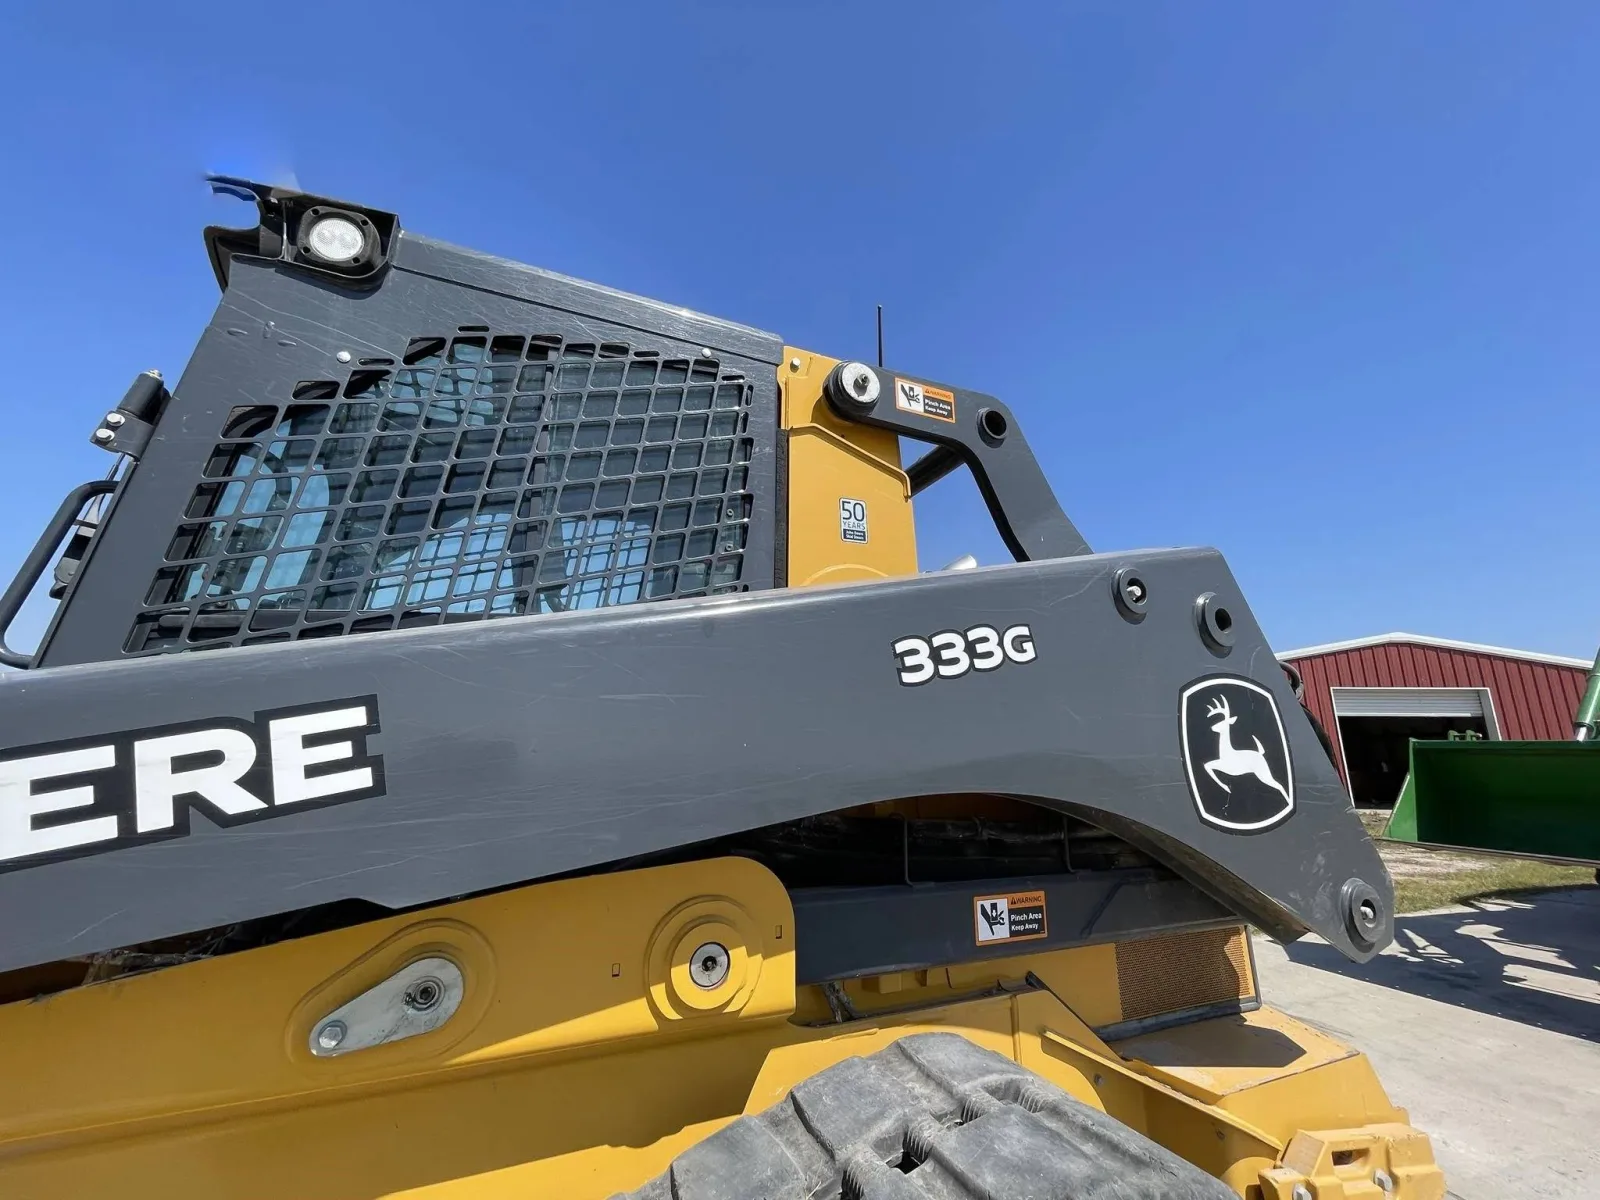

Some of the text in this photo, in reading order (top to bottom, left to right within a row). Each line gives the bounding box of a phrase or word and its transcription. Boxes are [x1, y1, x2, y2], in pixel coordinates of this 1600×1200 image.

[924, 398, 939, 407] Pinch
[936, 408, 948, 416] Away
[842, 500, 865, 522] 50
[843, 521, 866, 530] YEARS
[893, 625, 1037, 684] 333G
[0, 705, 373, 861] ERE
[1016, 895, 1042, 905] WARNING
[1010, 911, 1043, 922] Pinch Area
[1011, 923, 1039, 932] Keep Away
